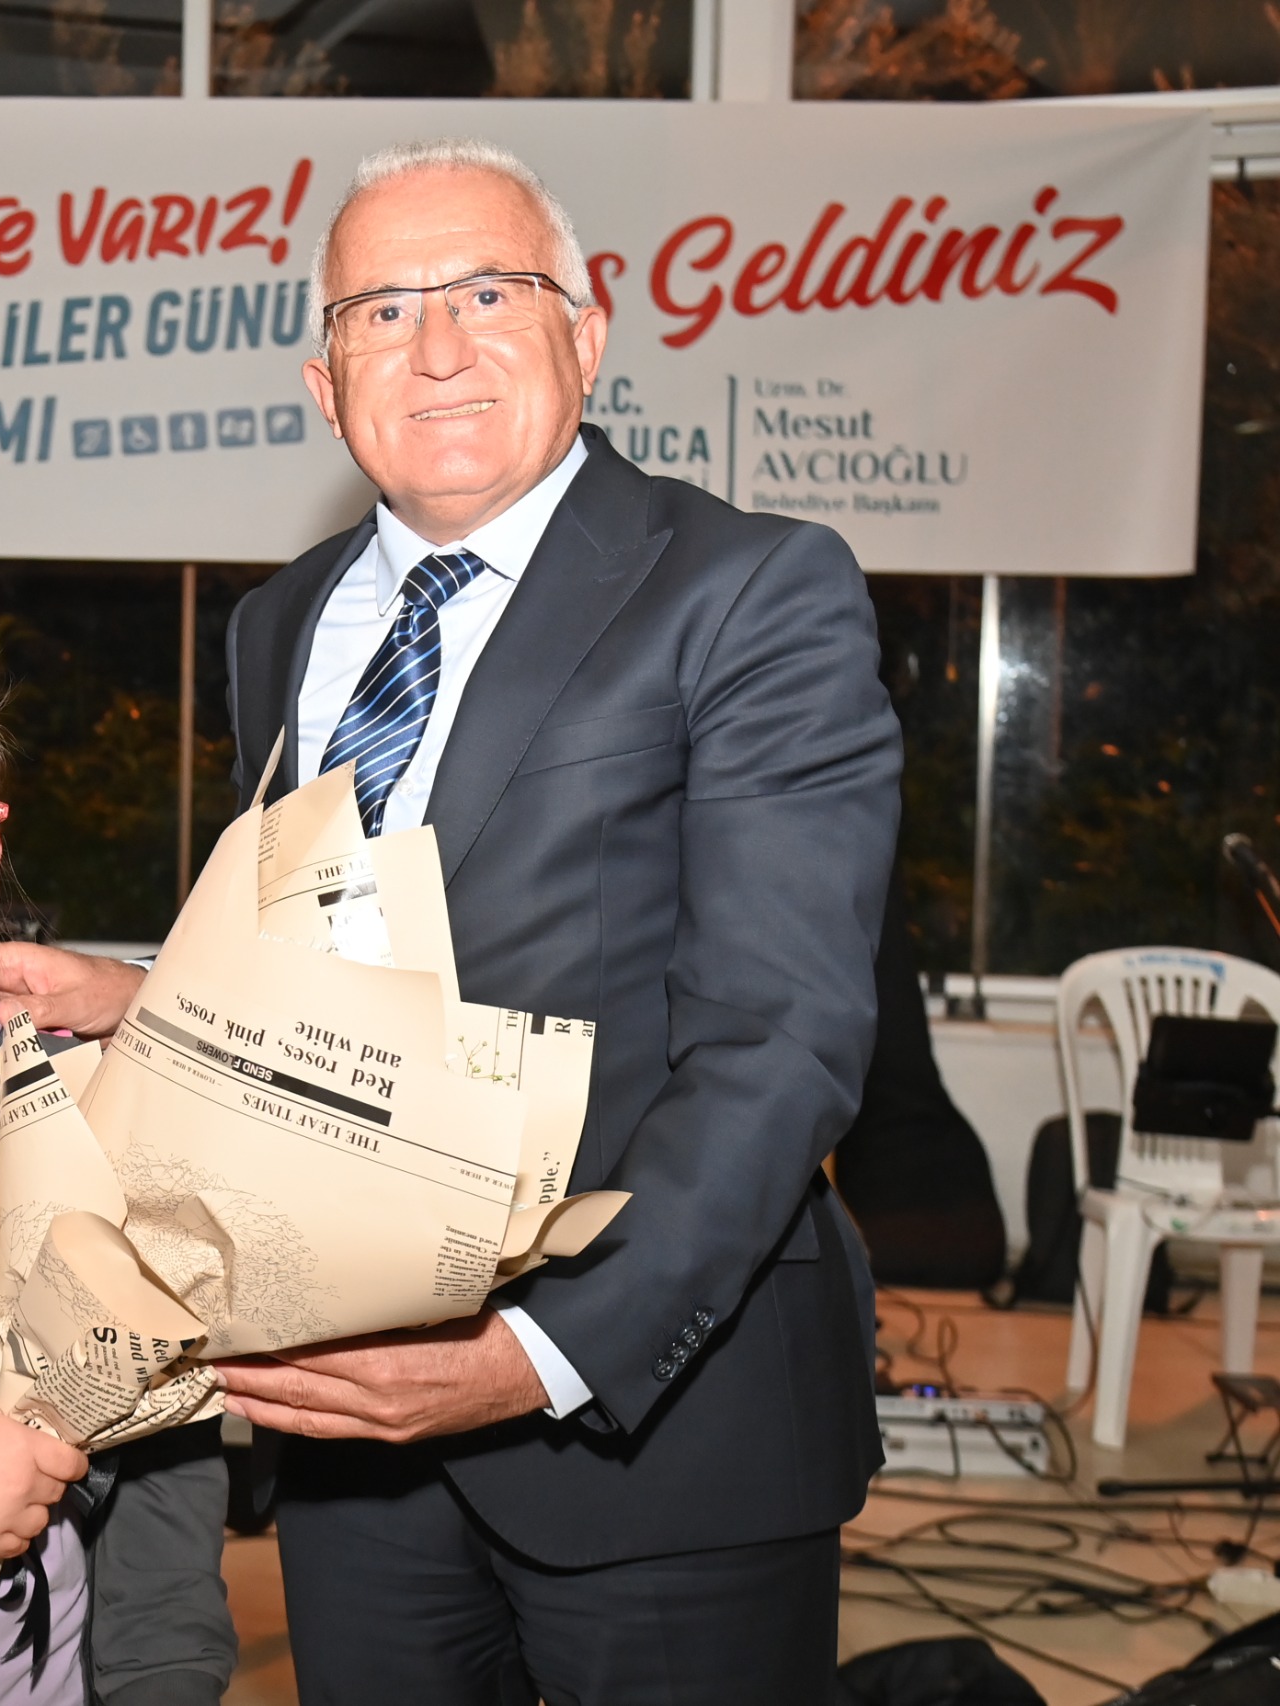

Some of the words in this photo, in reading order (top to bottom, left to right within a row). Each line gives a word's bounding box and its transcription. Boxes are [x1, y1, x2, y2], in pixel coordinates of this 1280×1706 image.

[649, 186, 1125, 350] Geldiniz
[145, 279, 310, 357] GÜNÜ
[752, 406, 874, 440] Mesut
[605, 425, 711, 463] UCA
[752, 444, 970, 486] AVCIOĞLU
[175, 991, 217, 1026] roses,
[8, 1010, 32, 1038] and
[224, 1018, 266, 1047] pink
[294, 1020, 352, 1052] white
[11, 1034, 44, 1062] Red
[131, 1038, 152, 1059] THE
[196, 1039, 242, 1070] FLOWERS
[277, 1036, 338, 1075] roses,
[360, 1043, 403, 1070] and
[242, 1060, 274, 1082] SEND
[350, 1067, 397, 1100] Red
[38, 1087, 71, 1109] THE
[241, 1092, 293, 1122] TIMES
[295, 1115, 342, 1140] LEAF
[345, 1129, 381, 1153] THE
[444, 1236, 488, 1254] Chamomile
[445, 1225, 478, 1240] meaning
[129, 1332, 149, 1362] and
[152, 1338, 174, 1363] Red
[85, 1381, 116, 1396] established
[86, 1373, 100, 1382] from
[104, 1382, 126, 1392] cuttings
